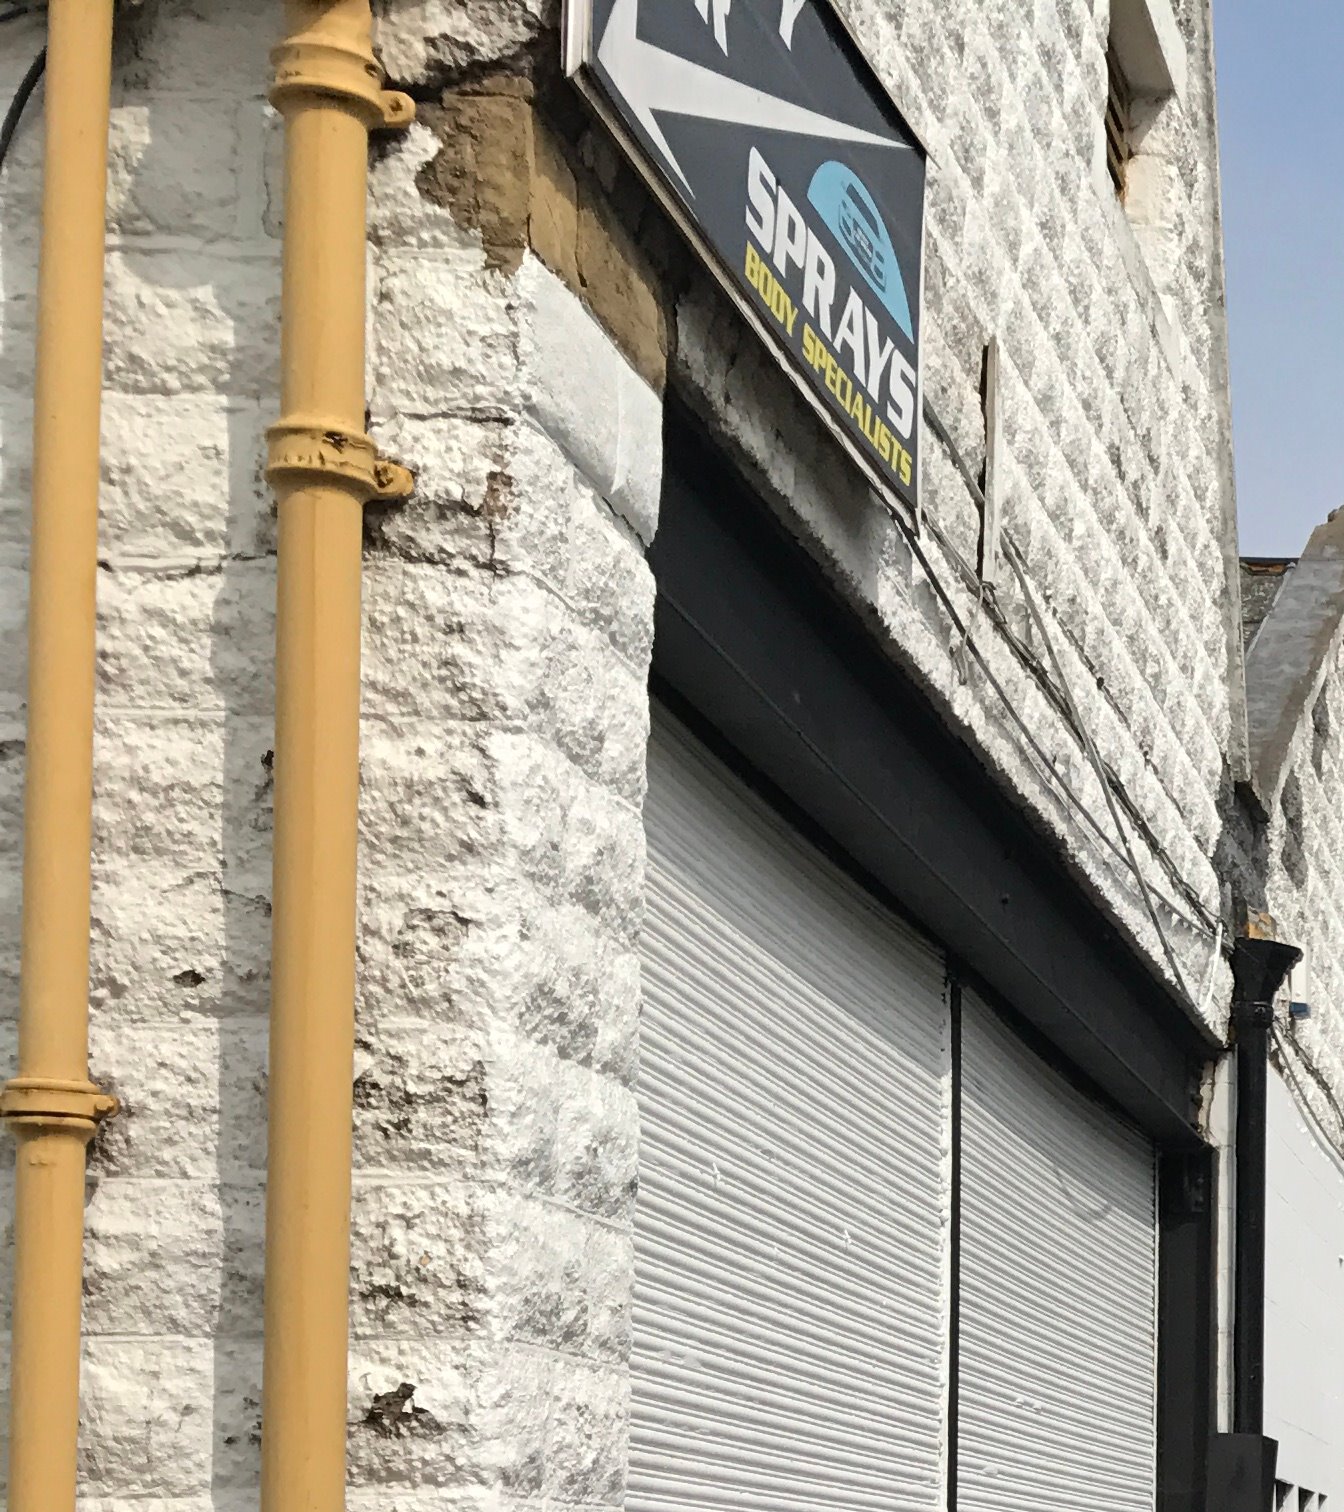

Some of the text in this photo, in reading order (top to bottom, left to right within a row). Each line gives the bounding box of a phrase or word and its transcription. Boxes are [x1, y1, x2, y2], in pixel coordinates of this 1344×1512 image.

[745, 146, 916, 439] SPRAYS
[745, 240, 912, 486] BODY SPECIALISTS
